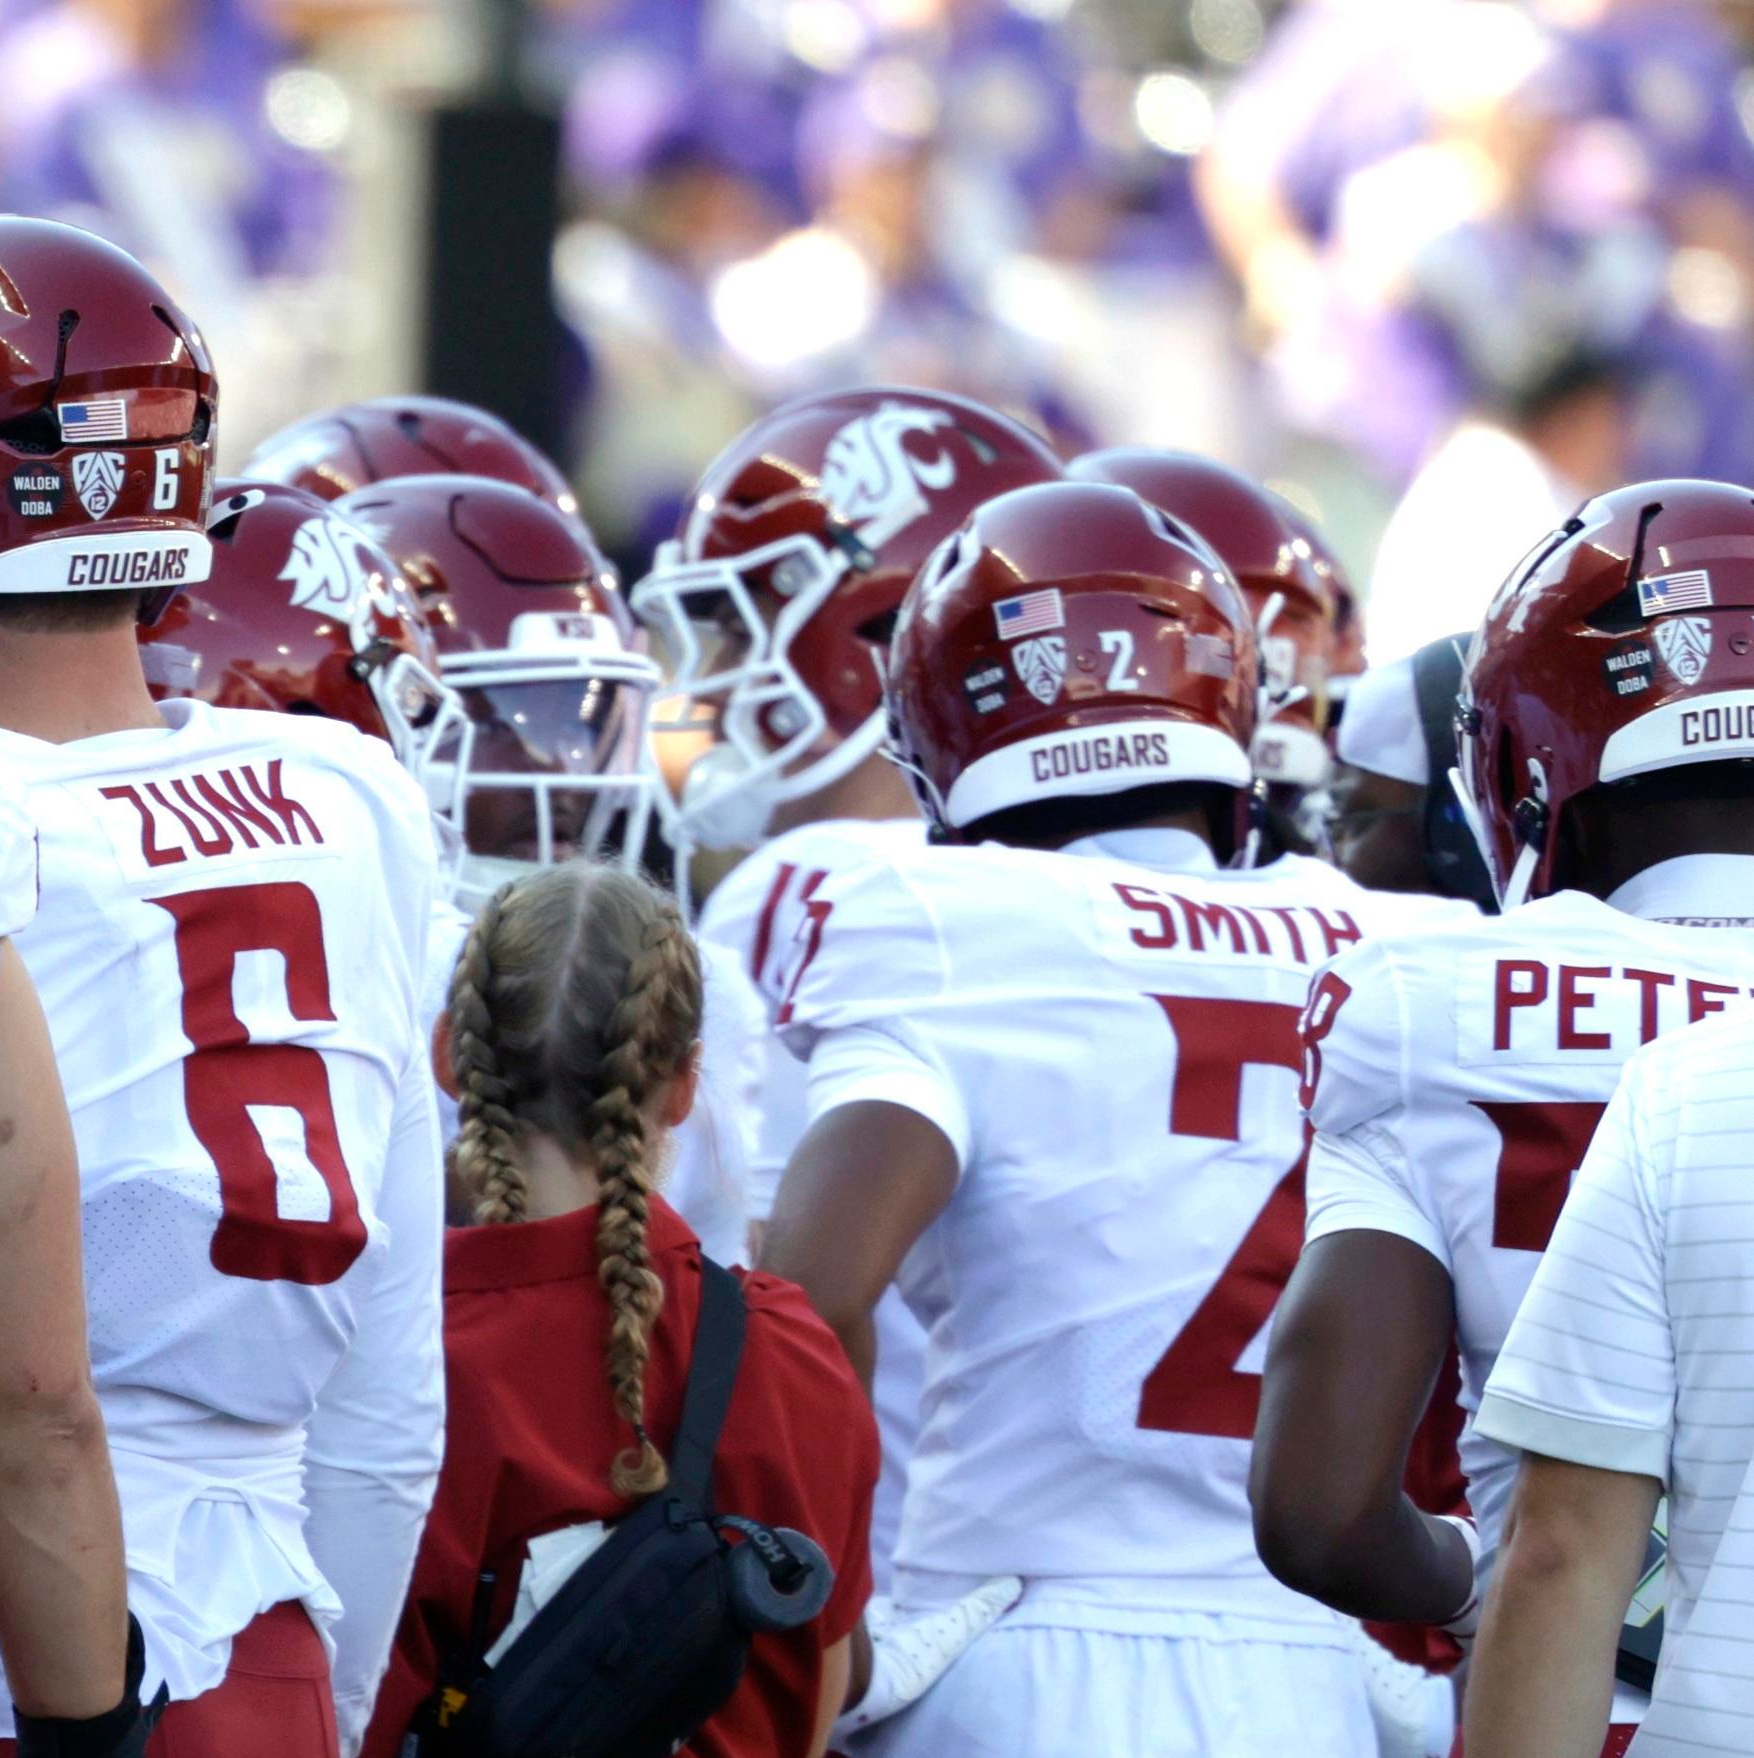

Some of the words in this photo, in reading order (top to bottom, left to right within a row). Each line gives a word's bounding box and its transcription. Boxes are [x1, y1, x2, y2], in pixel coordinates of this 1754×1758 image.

[14, 476, 60, 491] WALDEN
[21, 501, 53, 516] DOBA
[153, 448, 179, 511] 6
[67, 548, 189, 586] COUGARS
[1098, 630, 1140, 692] 2
[1606, 649, 1652, 672] WALDEN
[1681, 705, 1754, 746] COU
[1030, 733, 1170, 782] COUGARS
[98, 758, 325, 868] ZUNK
[1111, 883, 1364, 965] SMITH
[1493, 959, 1754, 1052] PETE
[141, 880, 369, 1286] 6
[1136, 992, 1310, 1441] 2
